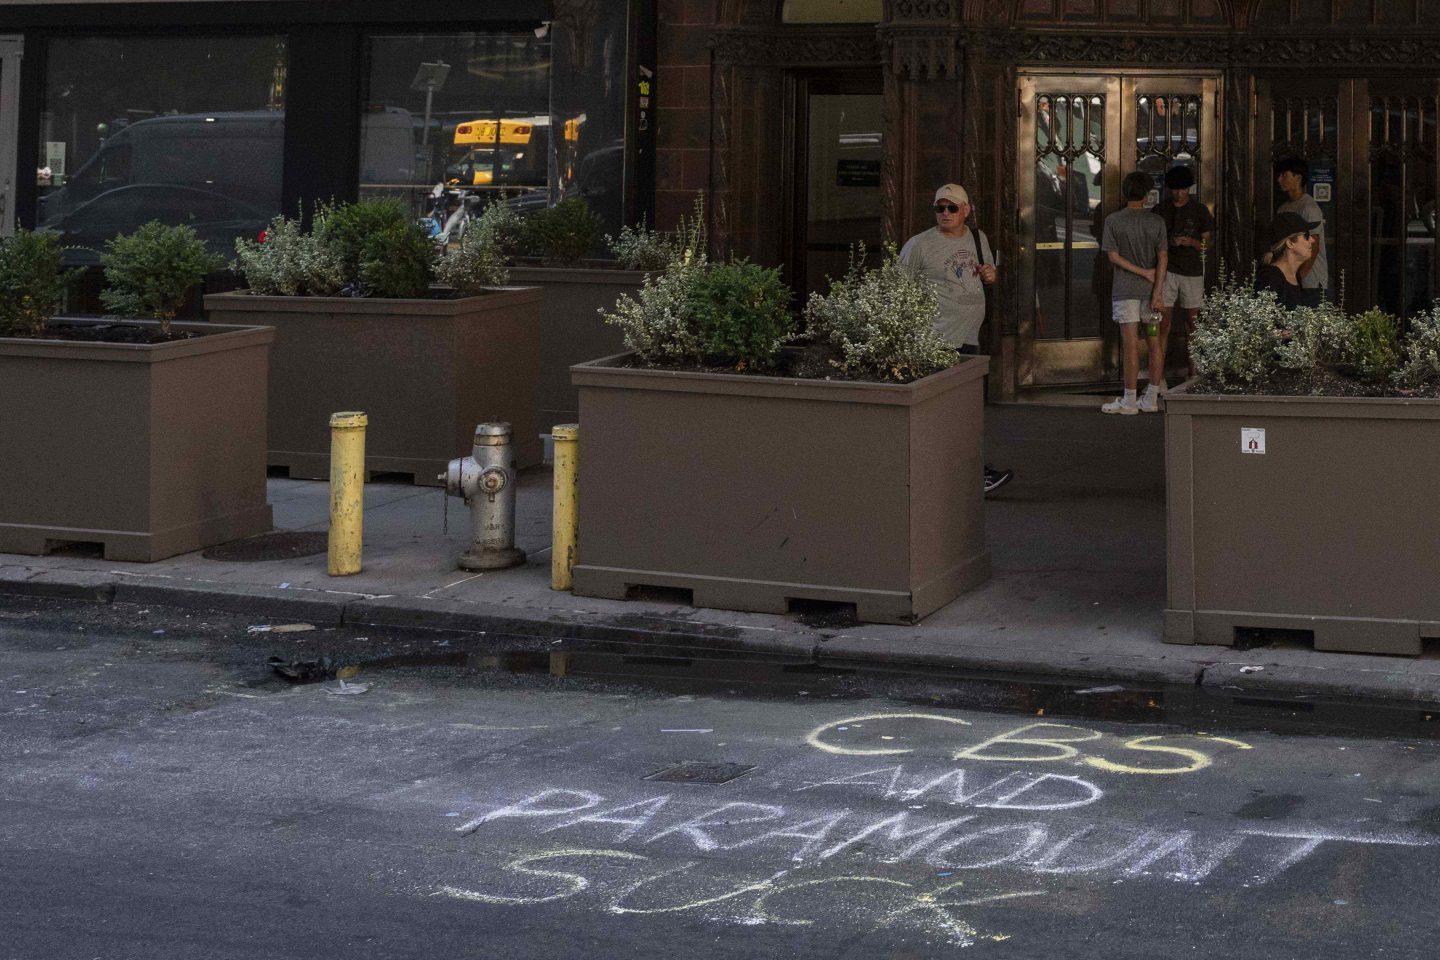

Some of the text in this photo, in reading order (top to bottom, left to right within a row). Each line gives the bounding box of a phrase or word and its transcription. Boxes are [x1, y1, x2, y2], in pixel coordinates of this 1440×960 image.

[805, 713, 1254, 775] CBS
[794, 764, 1105, 811] AND
[454, 787, 1430, 888] PARAMOUNT
[430, 848, 1050, 947] SUCK
